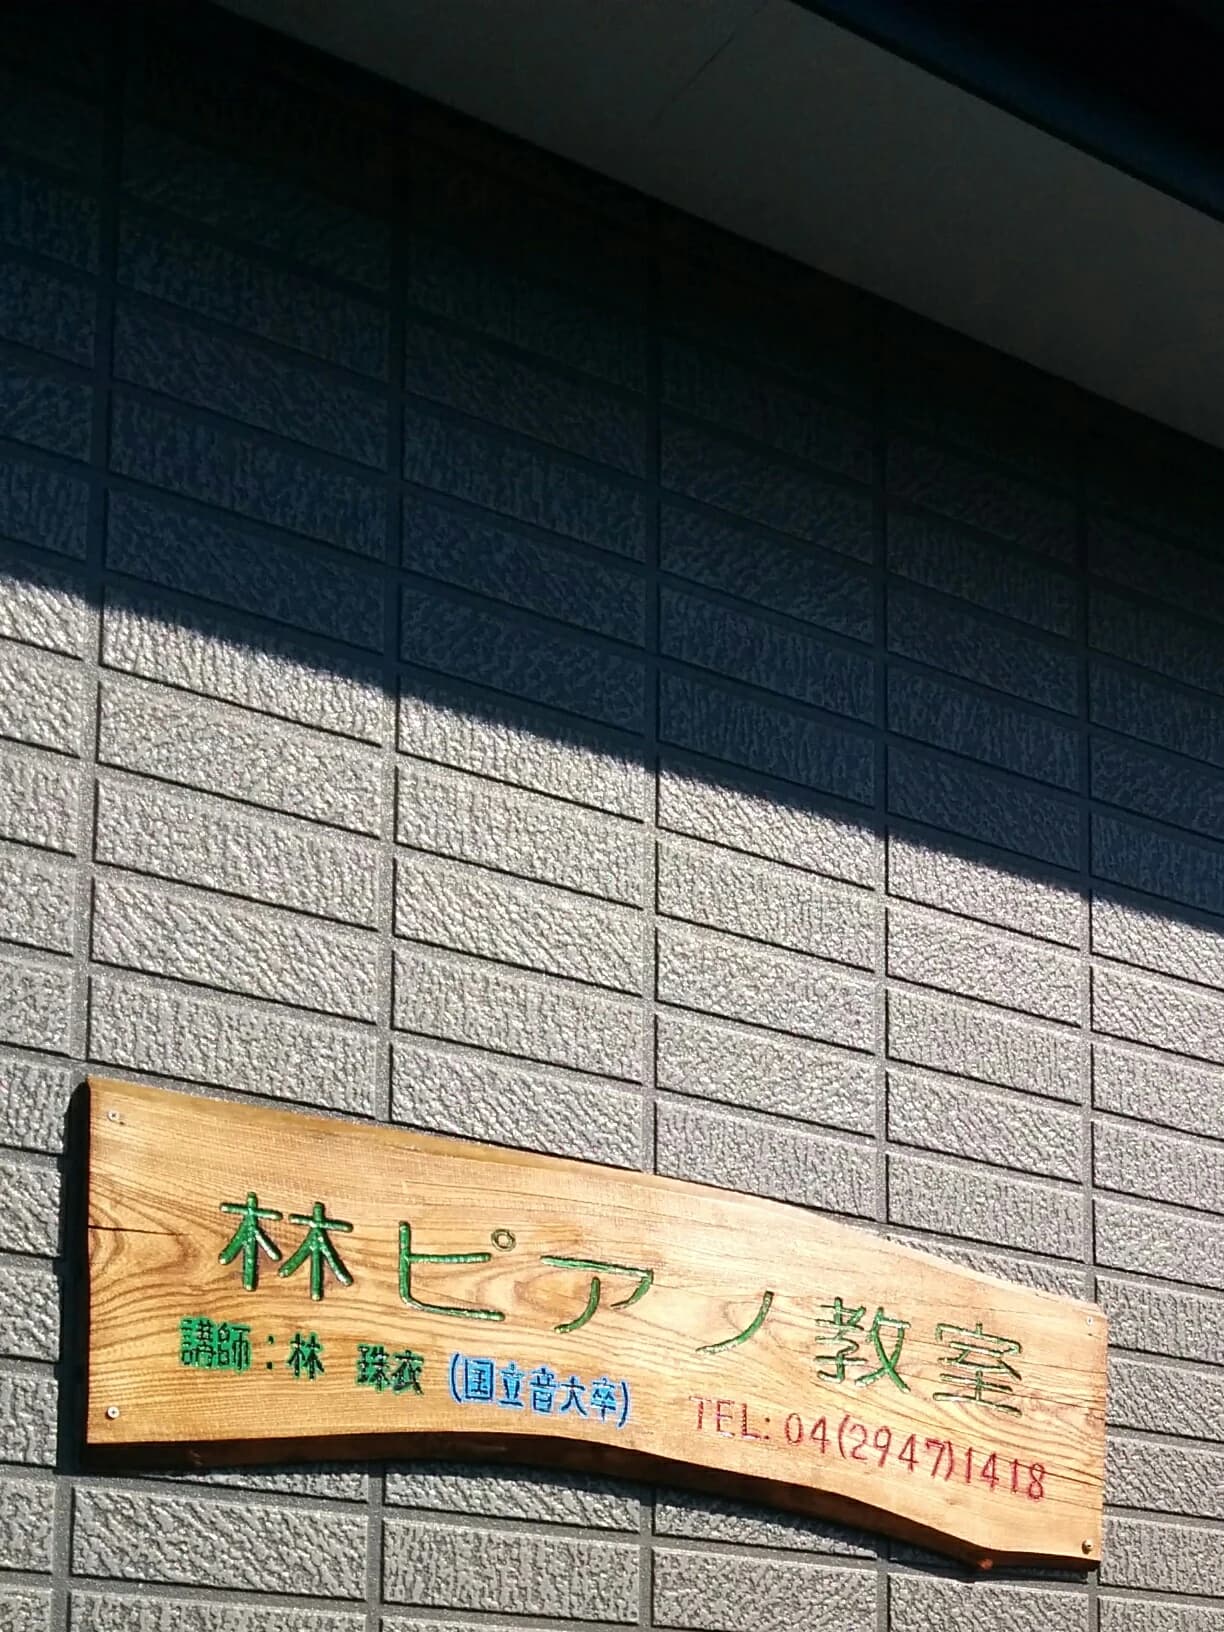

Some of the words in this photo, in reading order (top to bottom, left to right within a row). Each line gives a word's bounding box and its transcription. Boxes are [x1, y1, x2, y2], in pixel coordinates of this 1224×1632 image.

[218, 1192, 1022, 1417] 林ピアノ教室
[690, 1396, 771, 1440] TEL:
[784, 1413, 1047, 1500] 04(2947)1418
